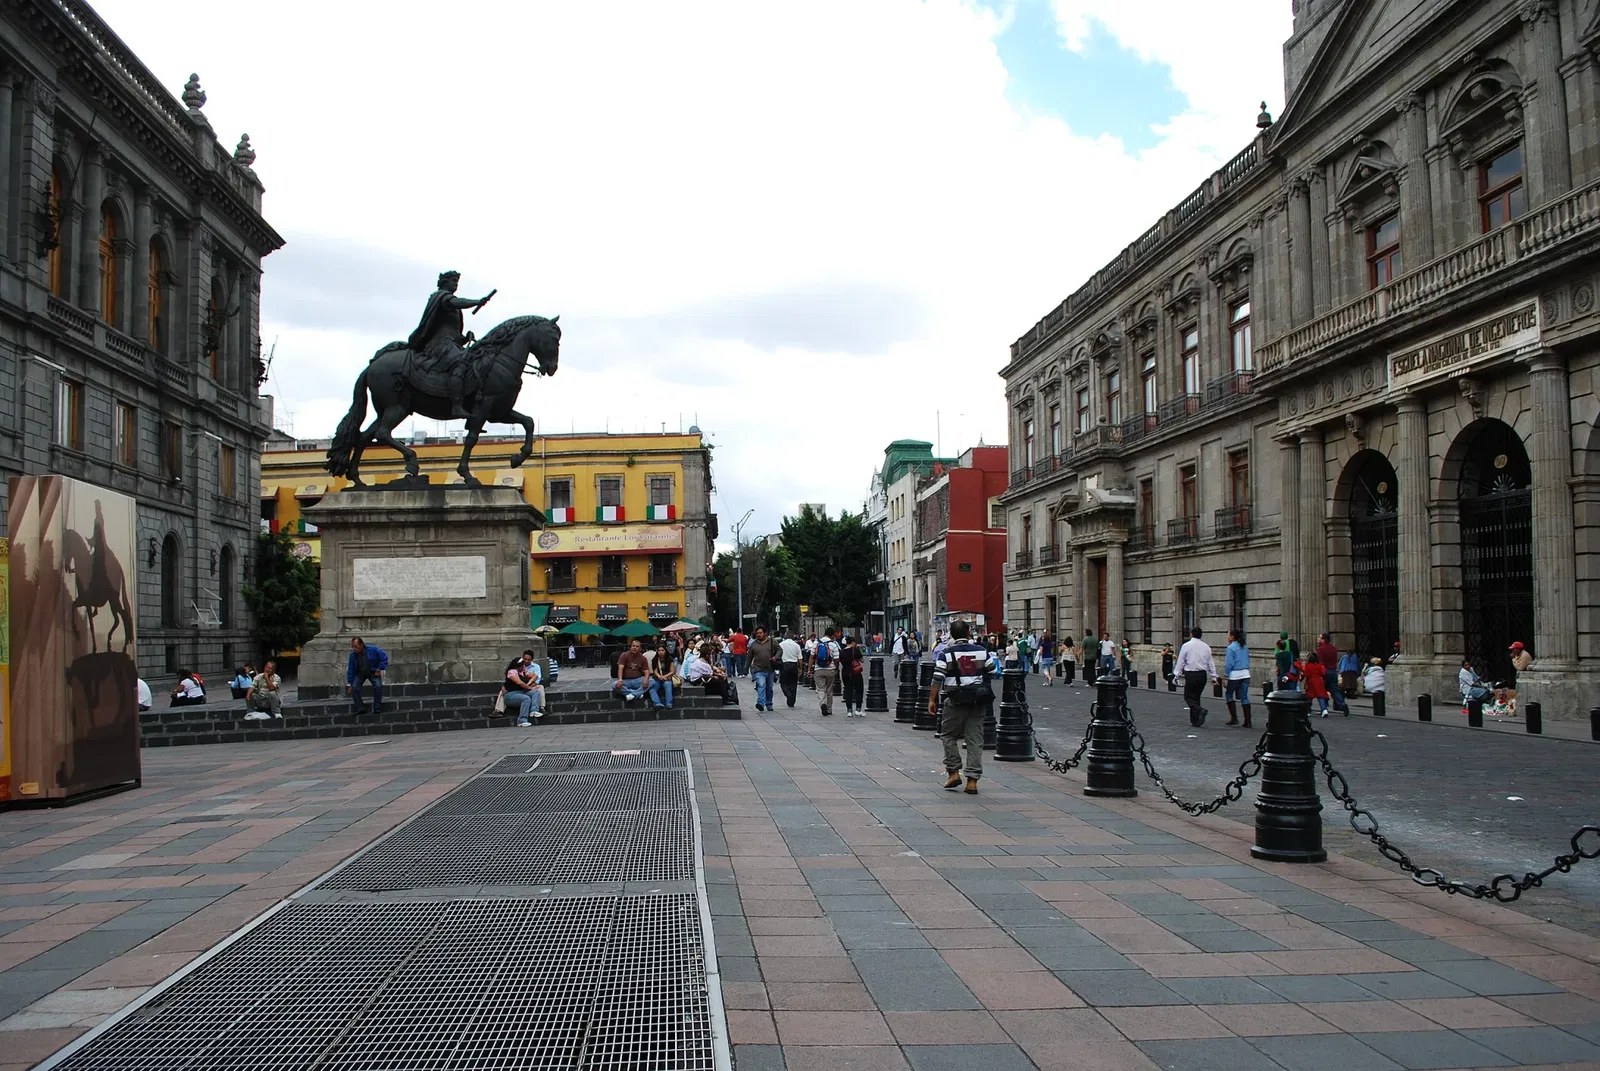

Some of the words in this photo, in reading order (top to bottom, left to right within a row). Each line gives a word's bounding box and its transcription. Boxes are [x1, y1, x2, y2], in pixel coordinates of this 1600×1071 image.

[1393, 350, 1428, 377] ESCUELA
[1427, 333, 1468, 364] NACIONAL
[1469, 328, 1482, 348] DE
[1481, 307, 1536, 344] INGENIEROS
[574, 535, 621, 544] Restaurante
